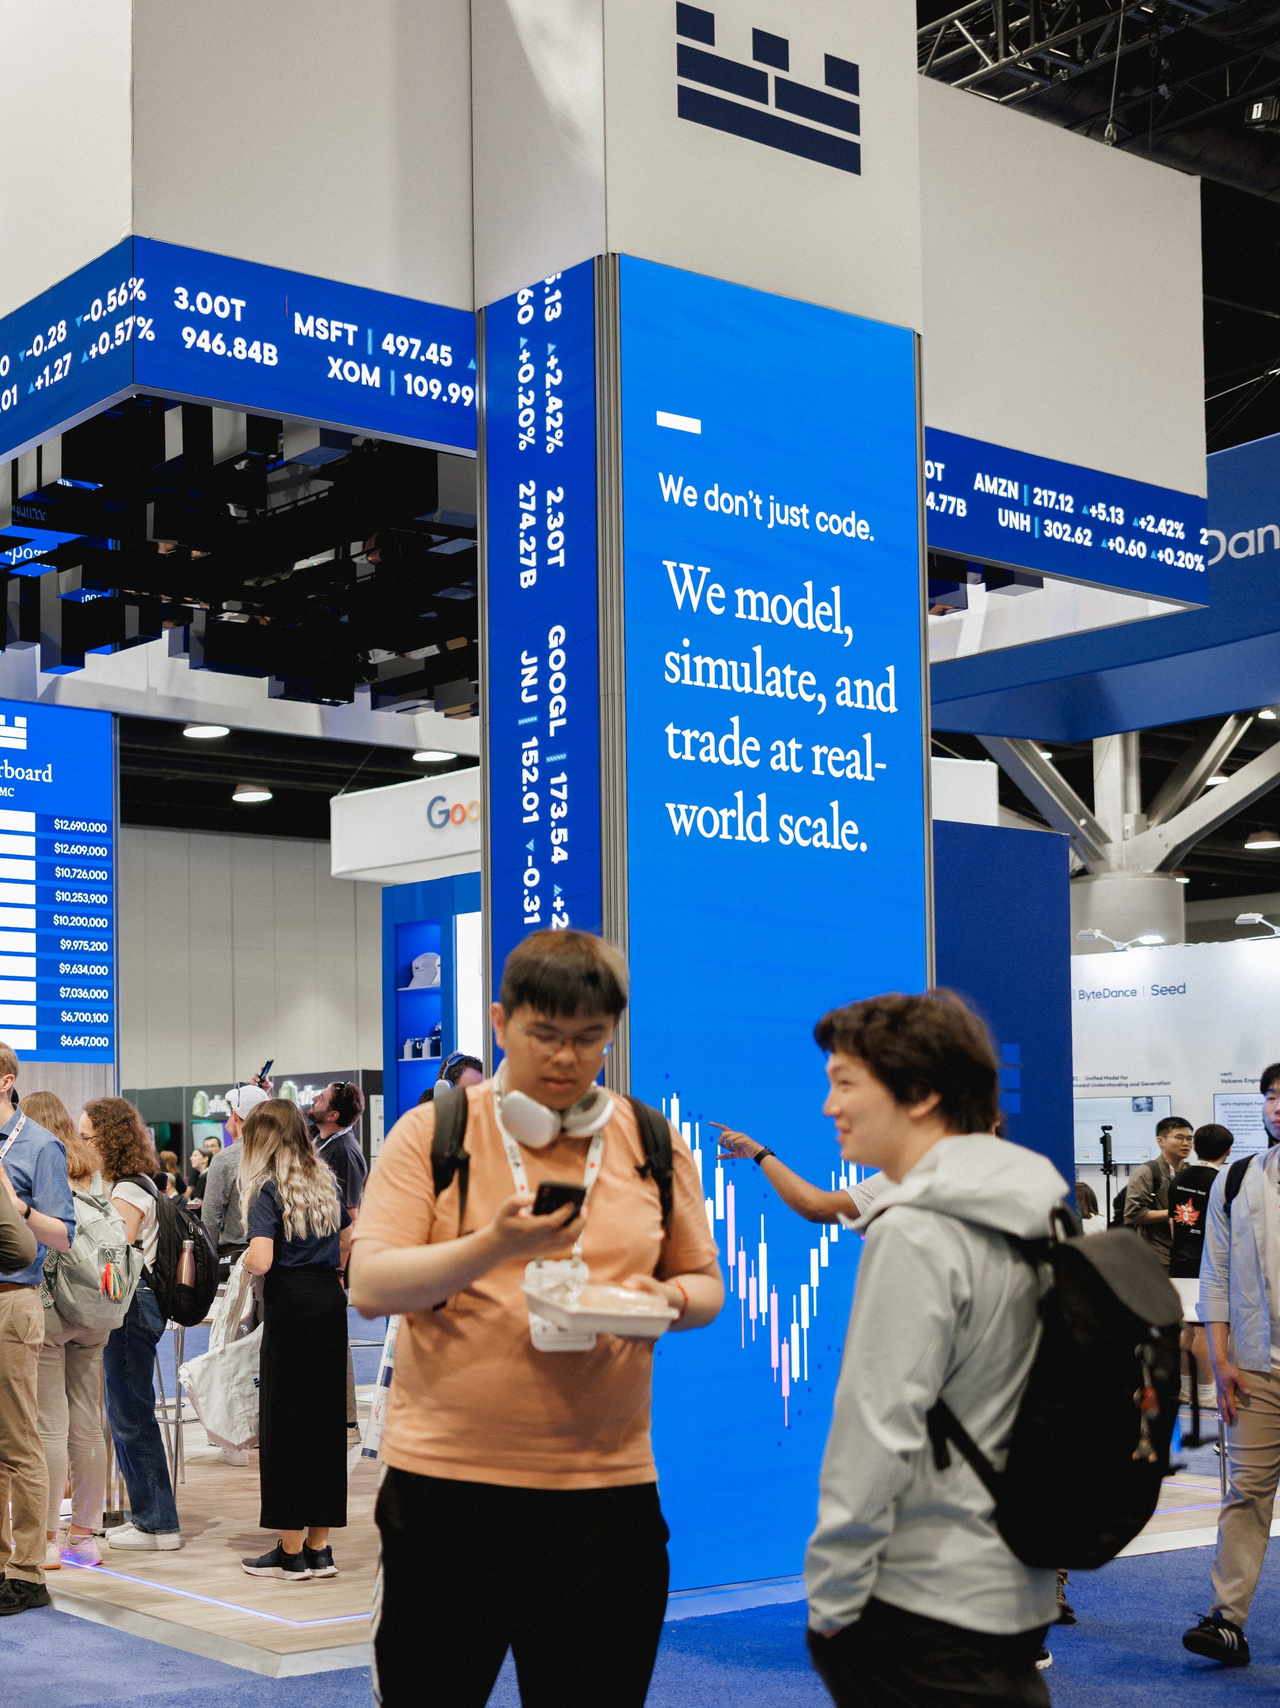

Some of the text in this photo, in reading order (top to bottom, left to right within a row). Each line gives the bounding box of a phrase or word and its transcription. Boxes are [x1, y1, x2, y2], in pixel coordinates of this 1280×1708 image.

[25, 319, 68, 358] -0.28
[83, 277, 147, 322] -0.56%
[174, 287, 452, 367] 3.00T MSFT 497.45
[35, 352, 72, 390] +1.27
[88, 315, 156, 359] +0.57%
[182, 327, 473, 406] 946.84B XOM 109.99
[518, 349, 535, 450] +0.20%
[546, 355, 563, 453] +2.42%
[519, 480, 536, 588] 274.27B
[547, 487, 564, 567] 2.30T
[659, 473, 874, 541] We don't just code.
[974, 473, 1018, 499] AMZN
[1034, 488, 1073, 513] 217.12
[1090, 503, 1124, 525] +5.13
[1139, 515, 1185, 539] +2.42%
[999, 508, 1030, 532] UNH
[1044, 520, 1092, 546] 302.62
[1108, 537, 1146, 558] +0.60
[1157, 548, 1205, 572] +0.20%
[663, 561, 853, 647] We model,
[521, 651, 538, 703] JNJ
[549, 625, 566, 737] GOOGL
[665, 638, 898, 715] simulate, and
[522, 737, 539, 823] 152.01
[665, 716, 886, 781] trade at real-
[55, 819, 107, 833] $12,690,000
[55, 843, 107, 856] $12,609,000
[550, 772, 568, 864] 173.54
[665, 790, 867, 852] world scale.
[55, 867, 107, 880] $10,726,000
[56, 891, 107, 904] $10,253,900
[524, 856, 540, 923] -0.31
[54, 914, 107, 927] $10,200,000
[61, 939, 108, 951] $9,975,200
[60, 963, 108, 975] $9,634,000
[60, 987, 108, 999] $7,036,000
[1078, 982, 1186, 1001] ByteDance Seed
[61, 1011, 108, 1023] $6,700,100
[61, 1035, 108, 1047] $6,647,000
